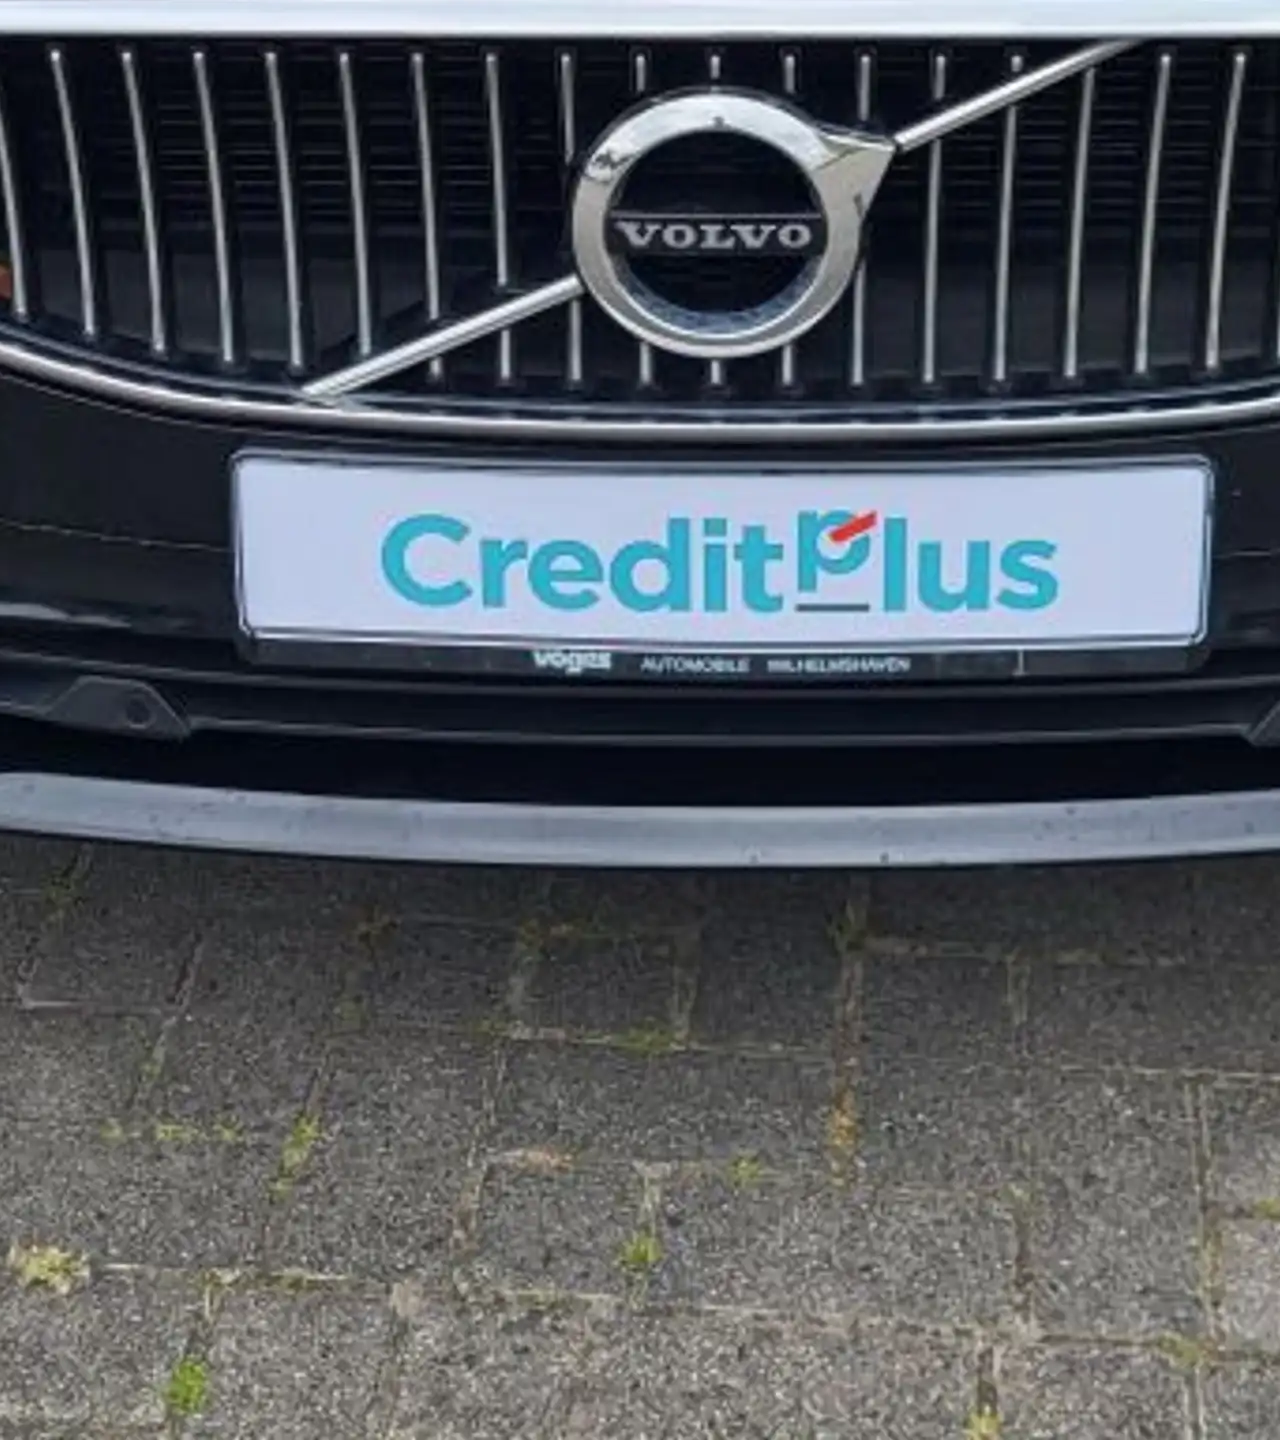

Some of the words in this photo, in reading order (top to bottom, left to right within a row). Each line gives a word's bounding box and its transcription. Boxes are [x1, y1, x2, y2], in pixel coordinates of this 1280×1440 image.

[615, 220, 813, 250] VOLVO
[380, 510, 1060, 614] CreditPlus
[639, 655, 751, 674] AUTOMOBILE
